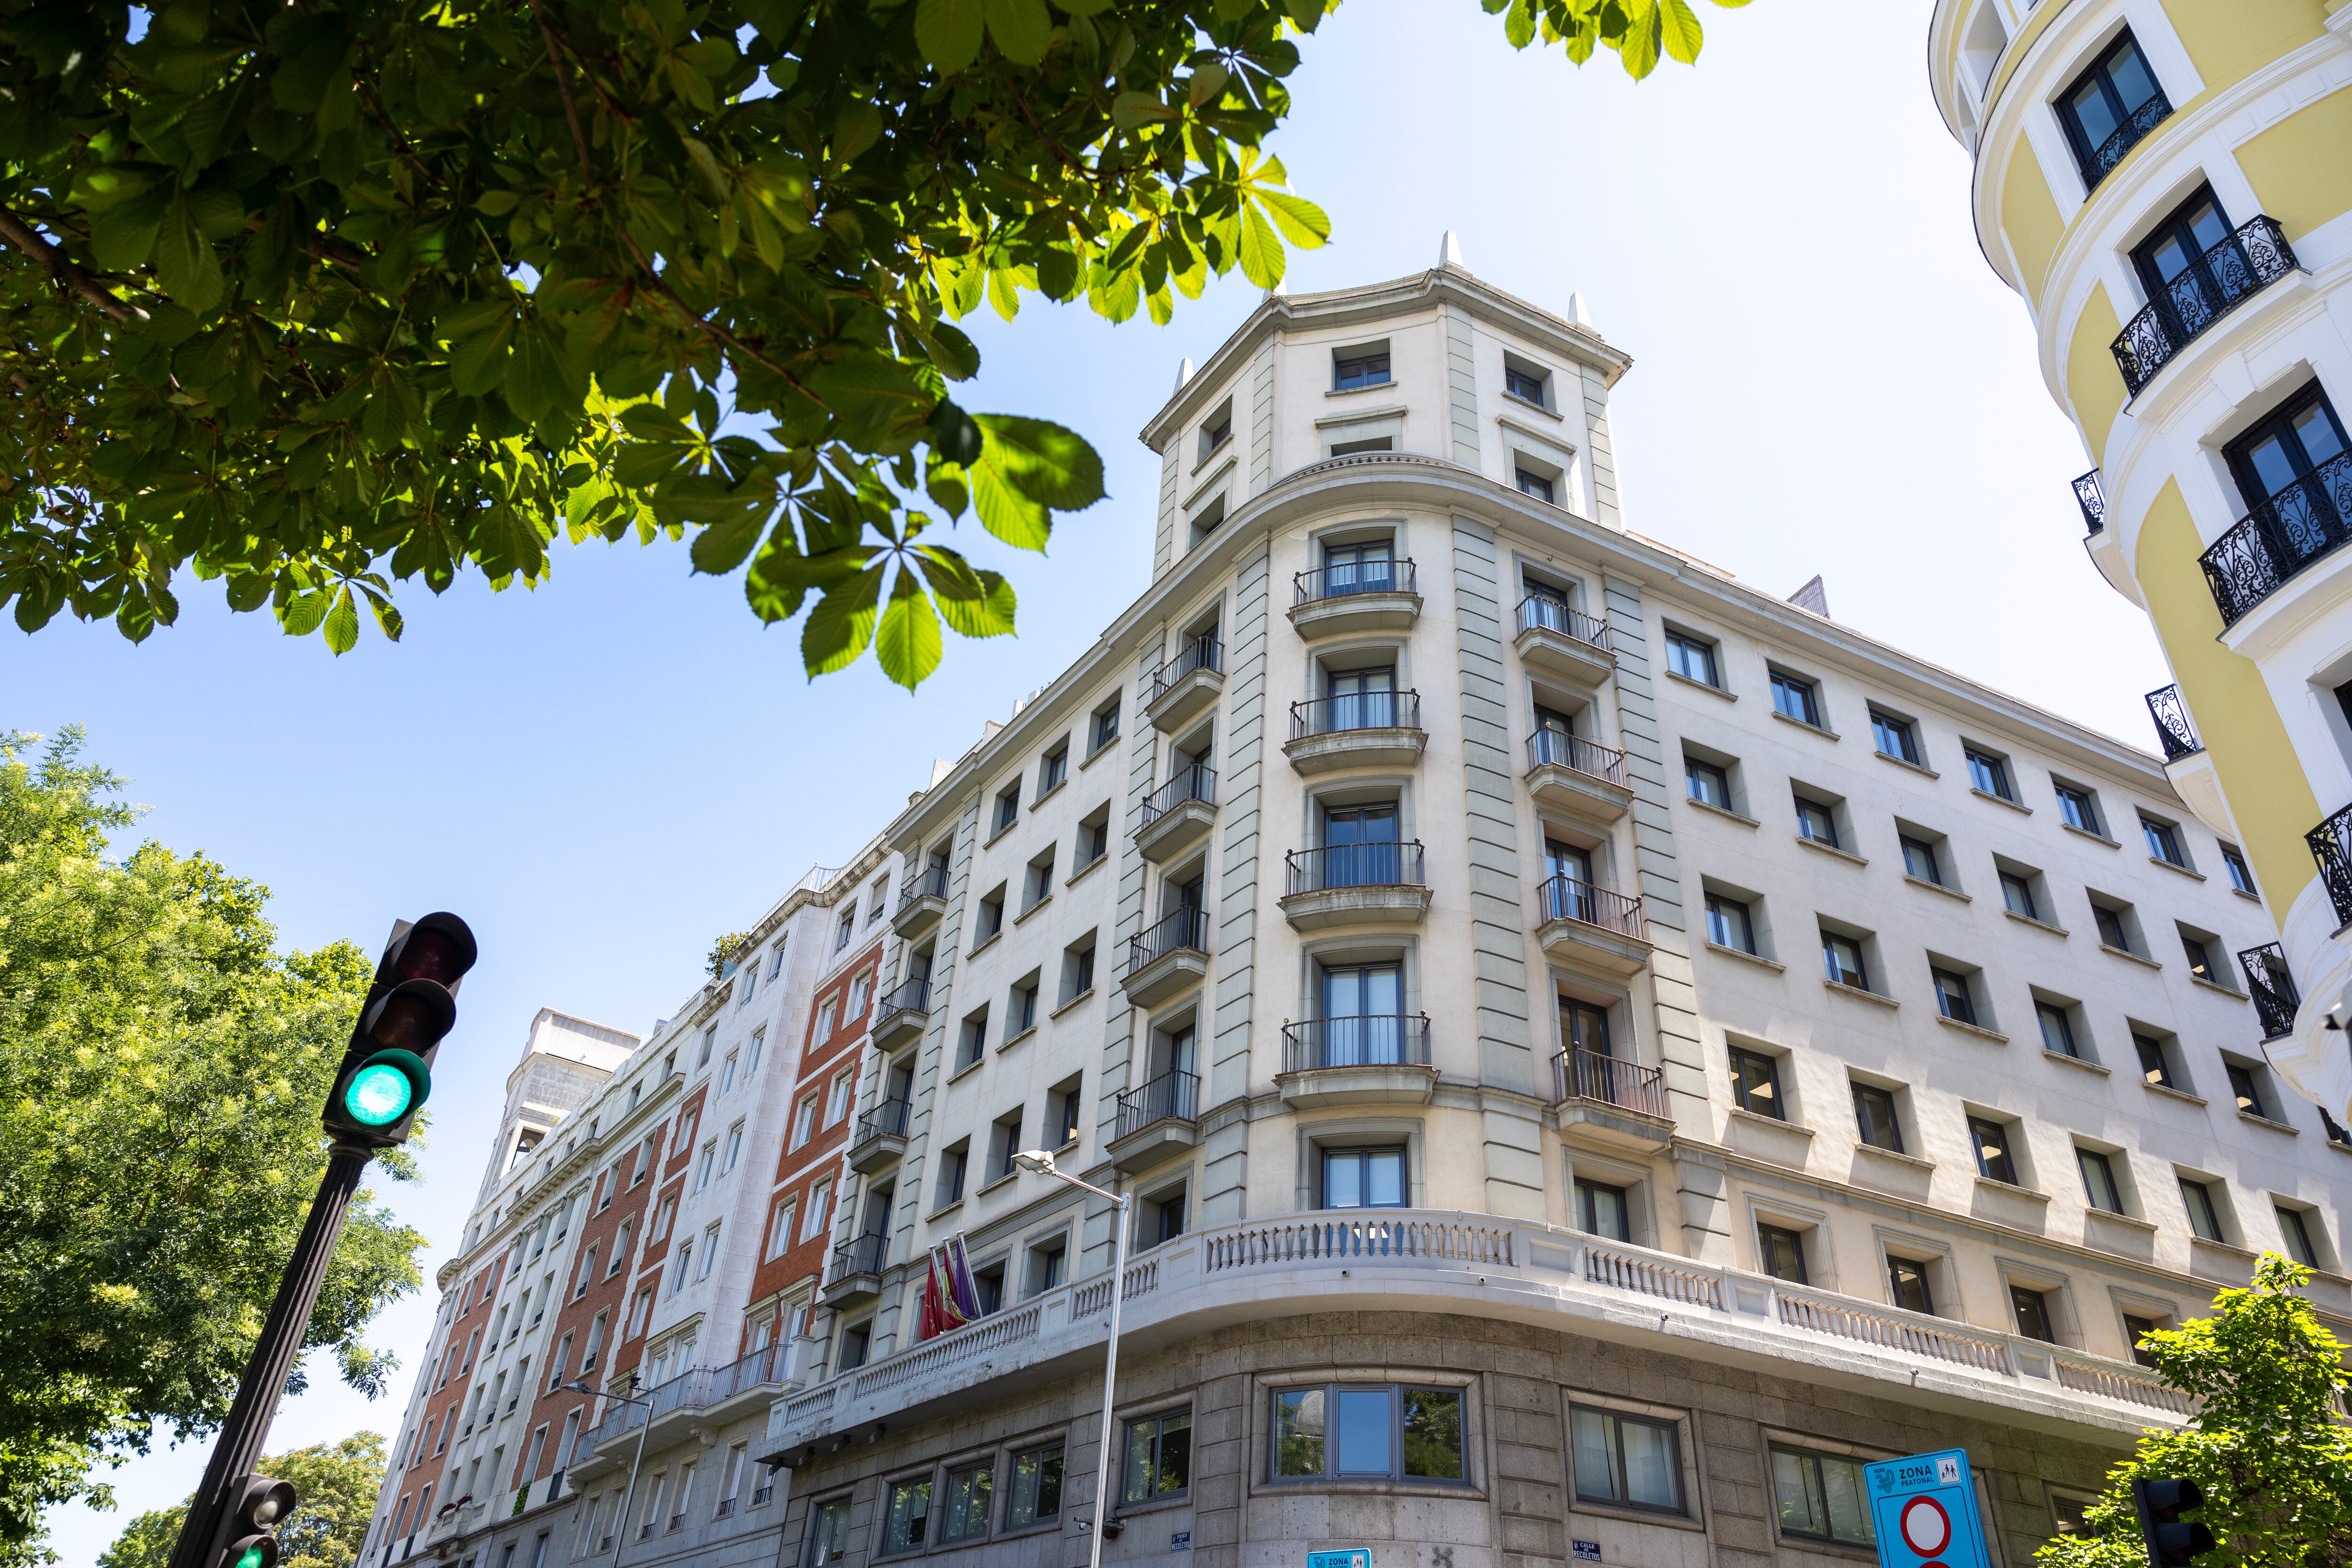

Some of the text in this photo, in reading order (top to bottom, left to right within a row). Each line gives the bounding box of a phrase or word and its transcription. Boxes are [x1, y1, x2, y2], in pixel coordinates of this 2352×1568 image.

[1899, 1465, 1932, 1479] ZONA
[1901, 1476, 1934, 1487] PEATONAL
[1172, 1541, 1190, 1551] RECOLETOS
[1573, 1550, 1600, 1561] RECOLETOS
